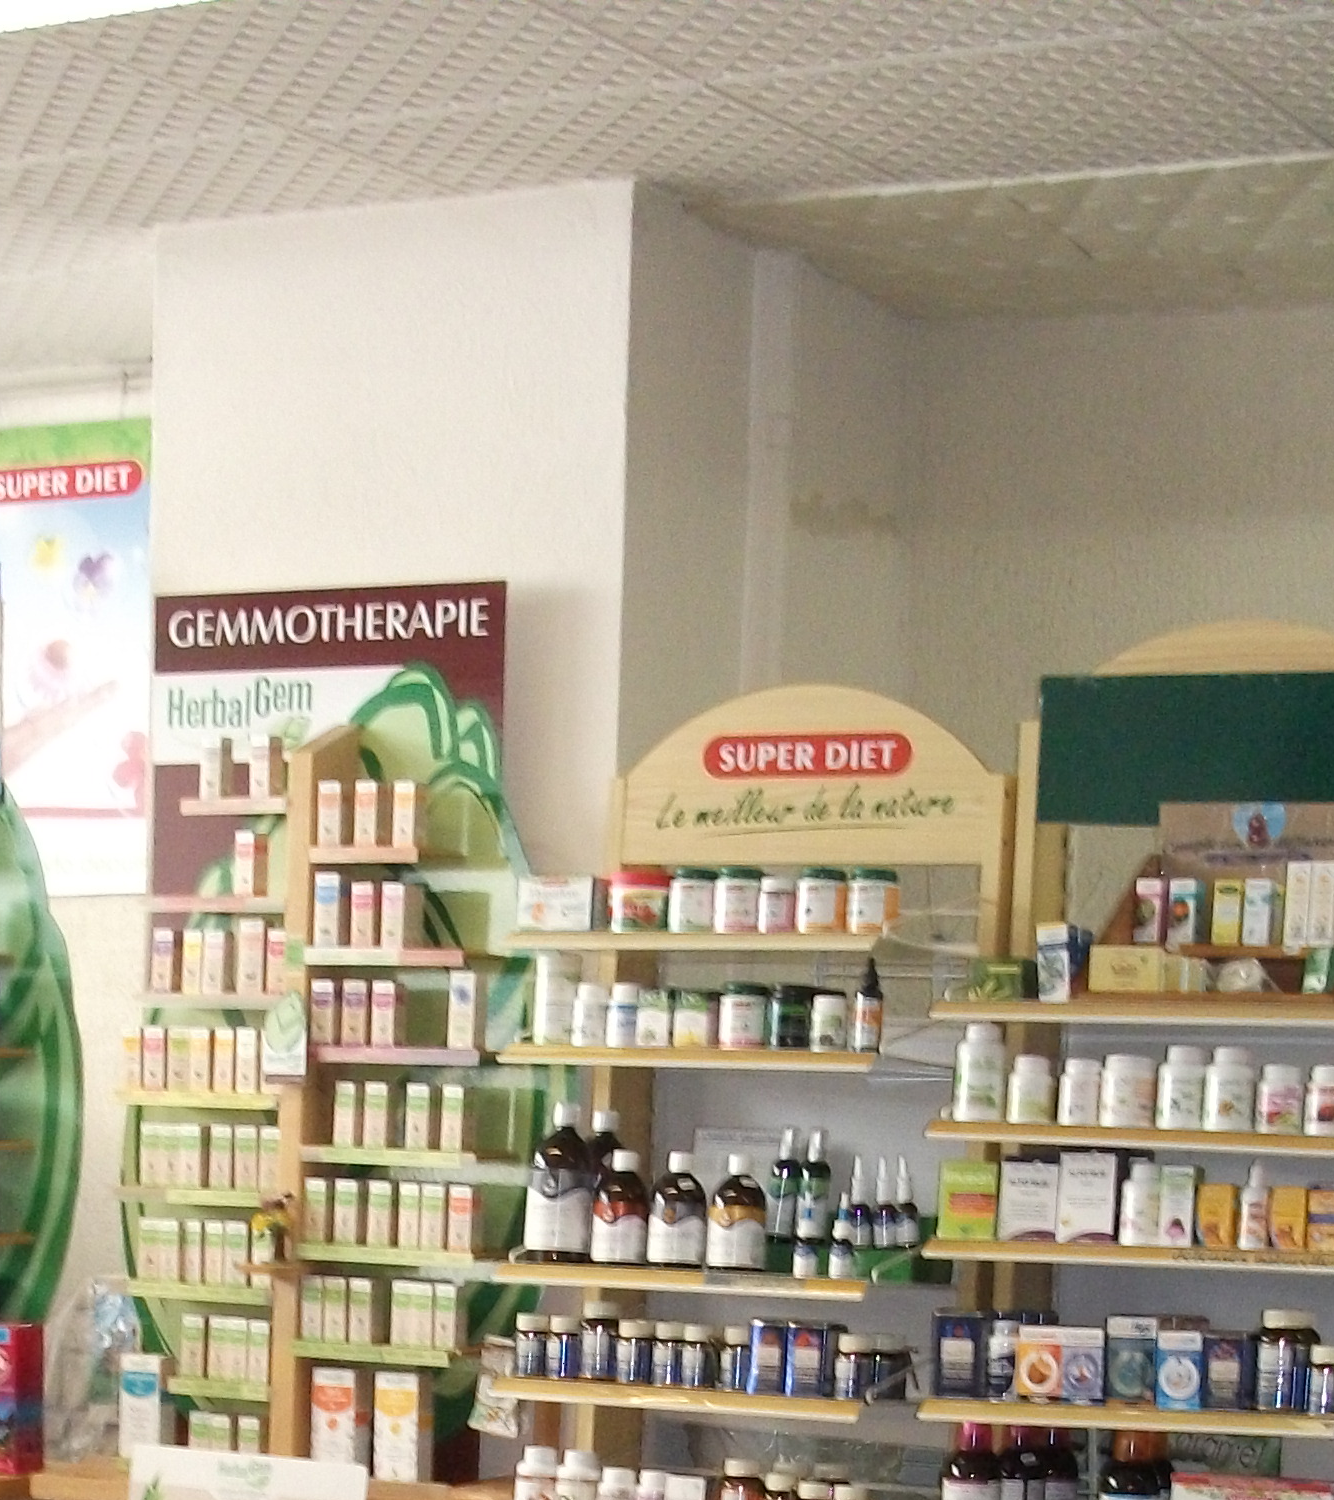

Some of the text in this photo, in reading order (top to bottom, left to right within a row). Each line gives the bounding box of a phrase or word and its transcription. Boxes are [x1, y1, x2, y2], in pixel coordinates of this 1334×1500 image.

[74, 465, 132, 495] DIET
[167, 597, 491, 650] GEMMOTHERAPIE
[717, 739, 897, 773] SUPER DIET
[692, 786, 796, 826] meilleur
[802, 784, 830, 822] de
[870, 787, 955, 819] nature
